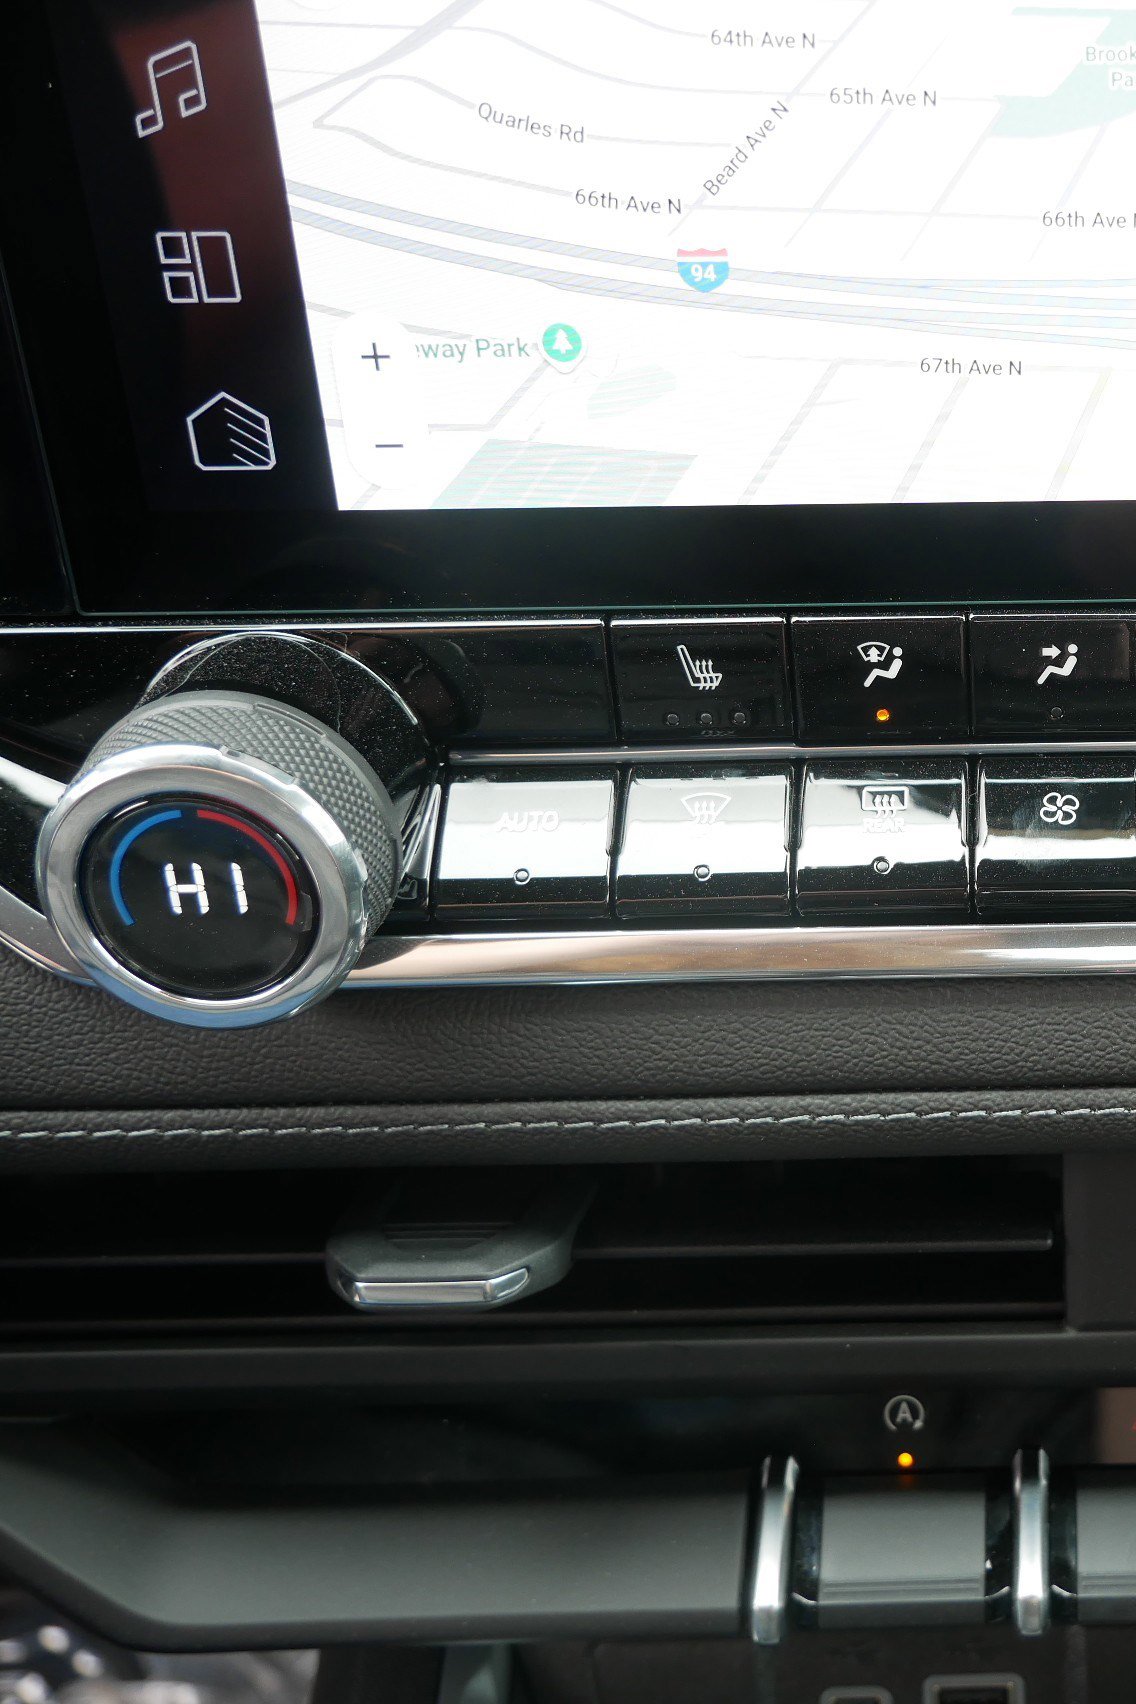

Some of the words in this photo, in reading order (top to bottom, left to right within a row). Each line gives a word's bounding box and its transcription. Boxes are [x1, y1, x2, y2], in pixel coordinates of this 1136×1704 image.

[710, 30, 754, 47] 64th
[761, 32, 796, 49] Ave
[802, 33, 817, 50] N
[829, 88, 874, 105] 65th
[881, 89, 916, 106] Ave
[922, 91, 937, 107] N
[477, 102, 552, 138] Quarles
[559, 125, 585, 144] Rd
[703, 144, 749, 197] Beard
[744, 121, 777, 153] Ave
[770, 101, 791, 121] N
[575, 188, 619, 210] 66th
[625, 195, 661, 214] Ave
[667, 198, 682, 215] N
[1042, 211, 1085, 228] 66th
[1091, 212, 1127, 229] Ave
[690, 264, 718, 284] 94
[475, 337, 530, 358] Park
[920, 358, 962, 375] 67th
[968, 360, 1003, 377] Ave
[1008, 361, 1023, 377] N
[497, 810, 559, 833] AUTO
[862, 819, 905, 834] REAR
[163, 861, 249, 915] HI
